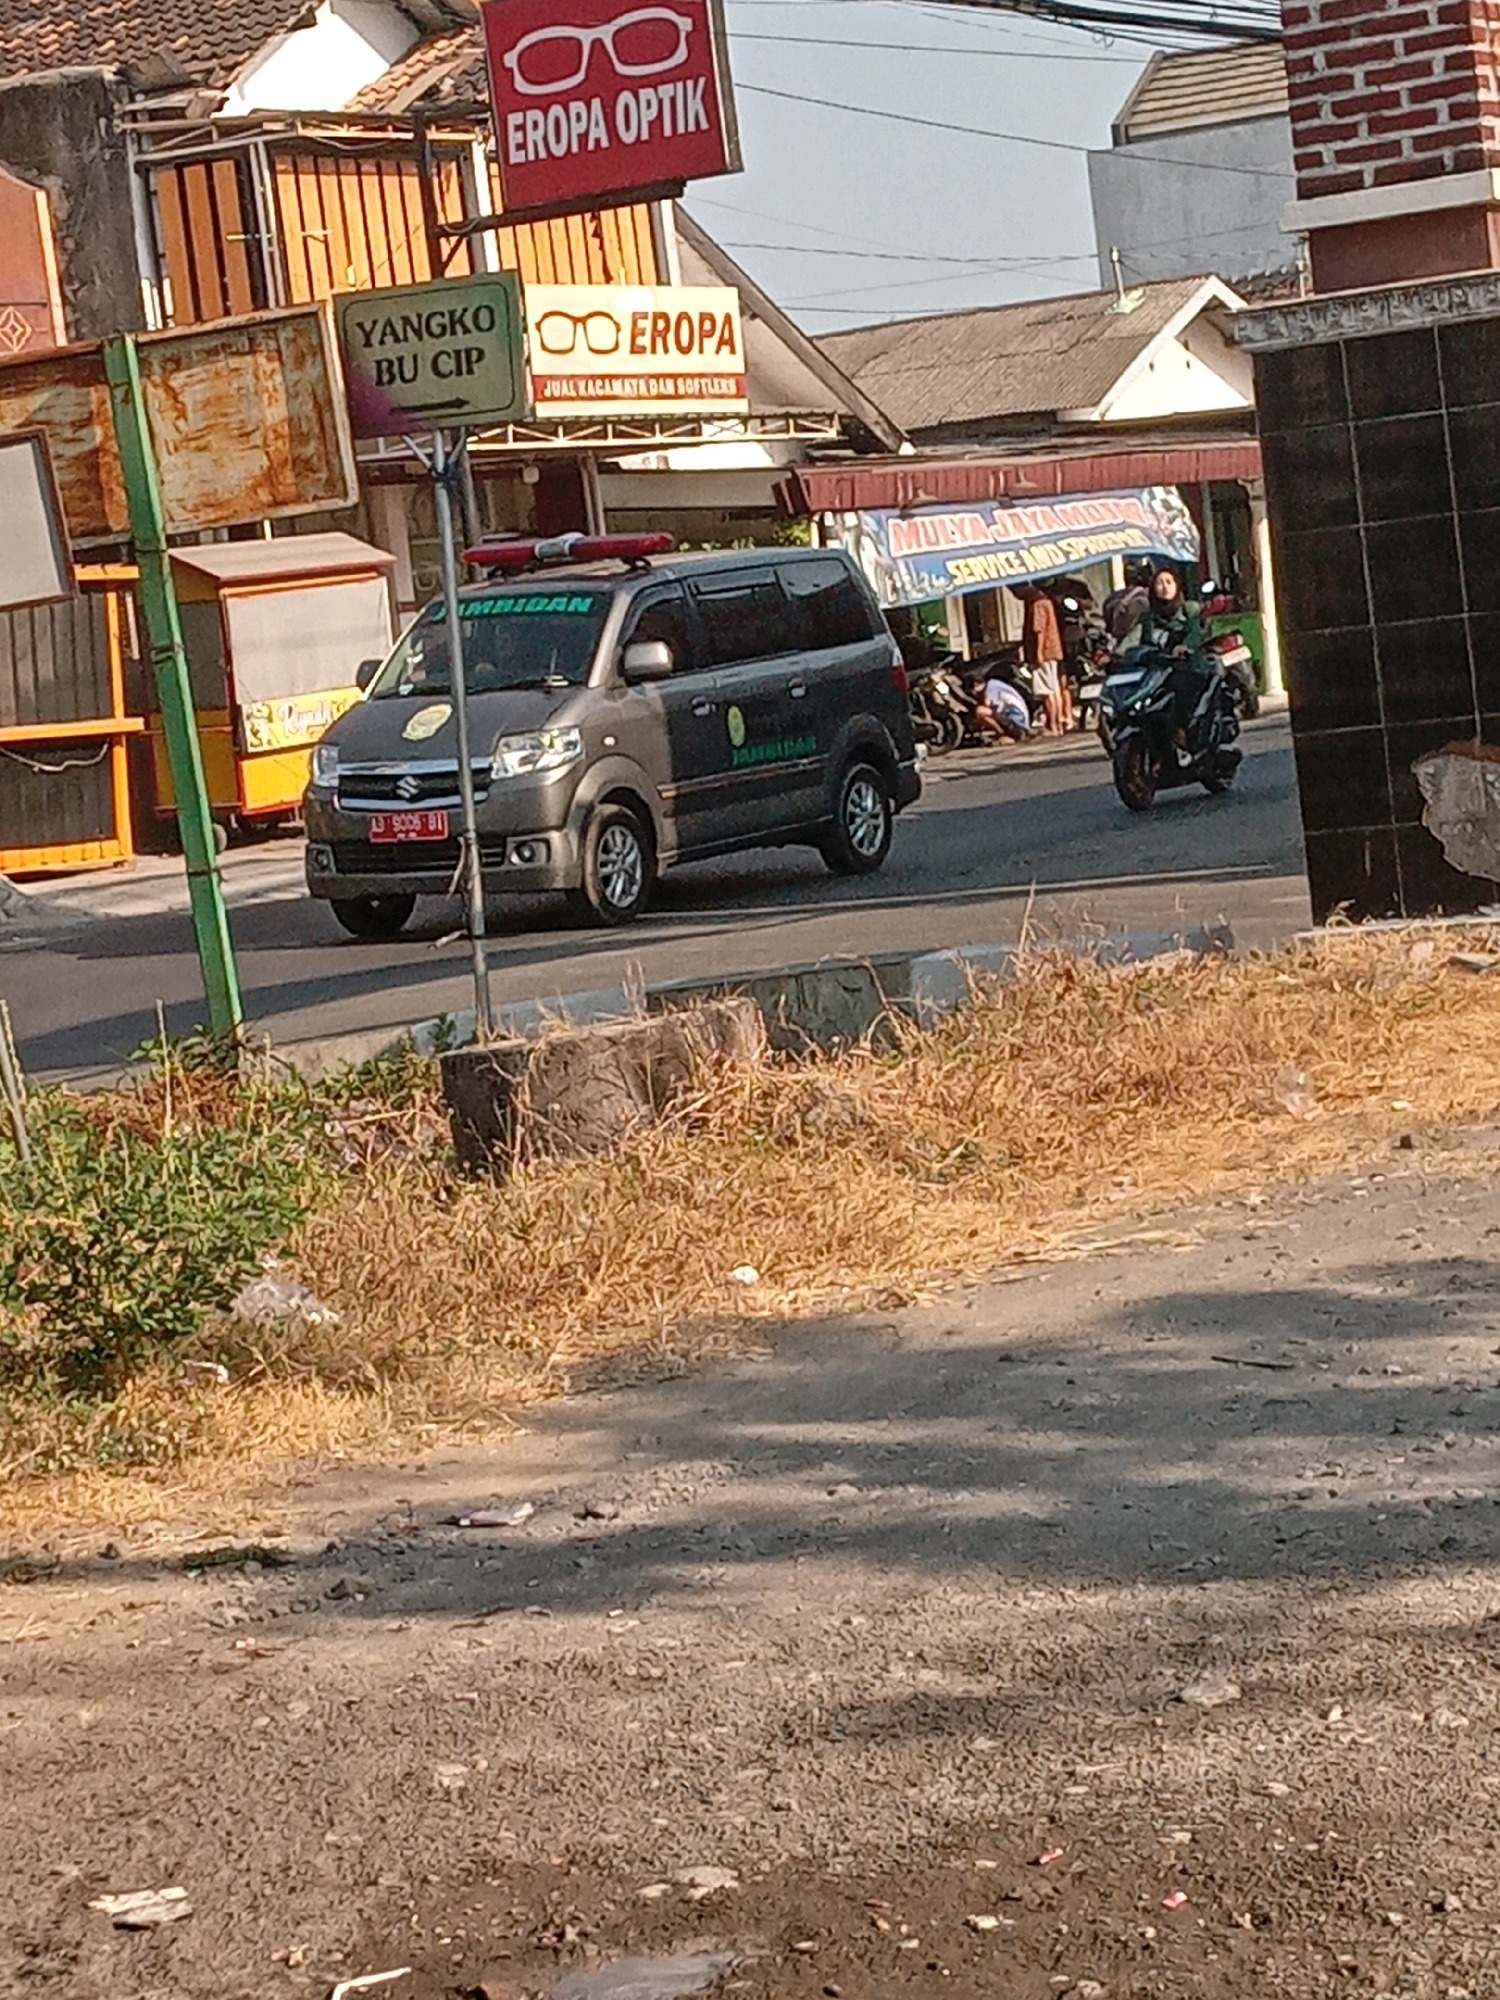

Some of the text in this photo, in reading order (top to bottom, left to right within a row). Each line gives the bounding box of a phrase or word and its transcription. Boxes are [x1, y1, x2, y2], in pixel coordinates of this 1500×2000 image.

[507, 76, 709, 165] EROPA OPTIK
[356, 304, 496, 348] YANGKO
[629, 311, 737, 355] EROPA
[373, 346, 486, 387] BU CIP
[543, 379, 577, 397] JUAL
[578, 378, 647, 397] KACAMATA
[649, 377, 676, 396] DAN
[889, 510, 994, 556] MULYA
[990, 504, 1067, 542] JAYA
[945, 552, 1027, 586] SERVICE
[1019, 539, 1067, 572] AND
